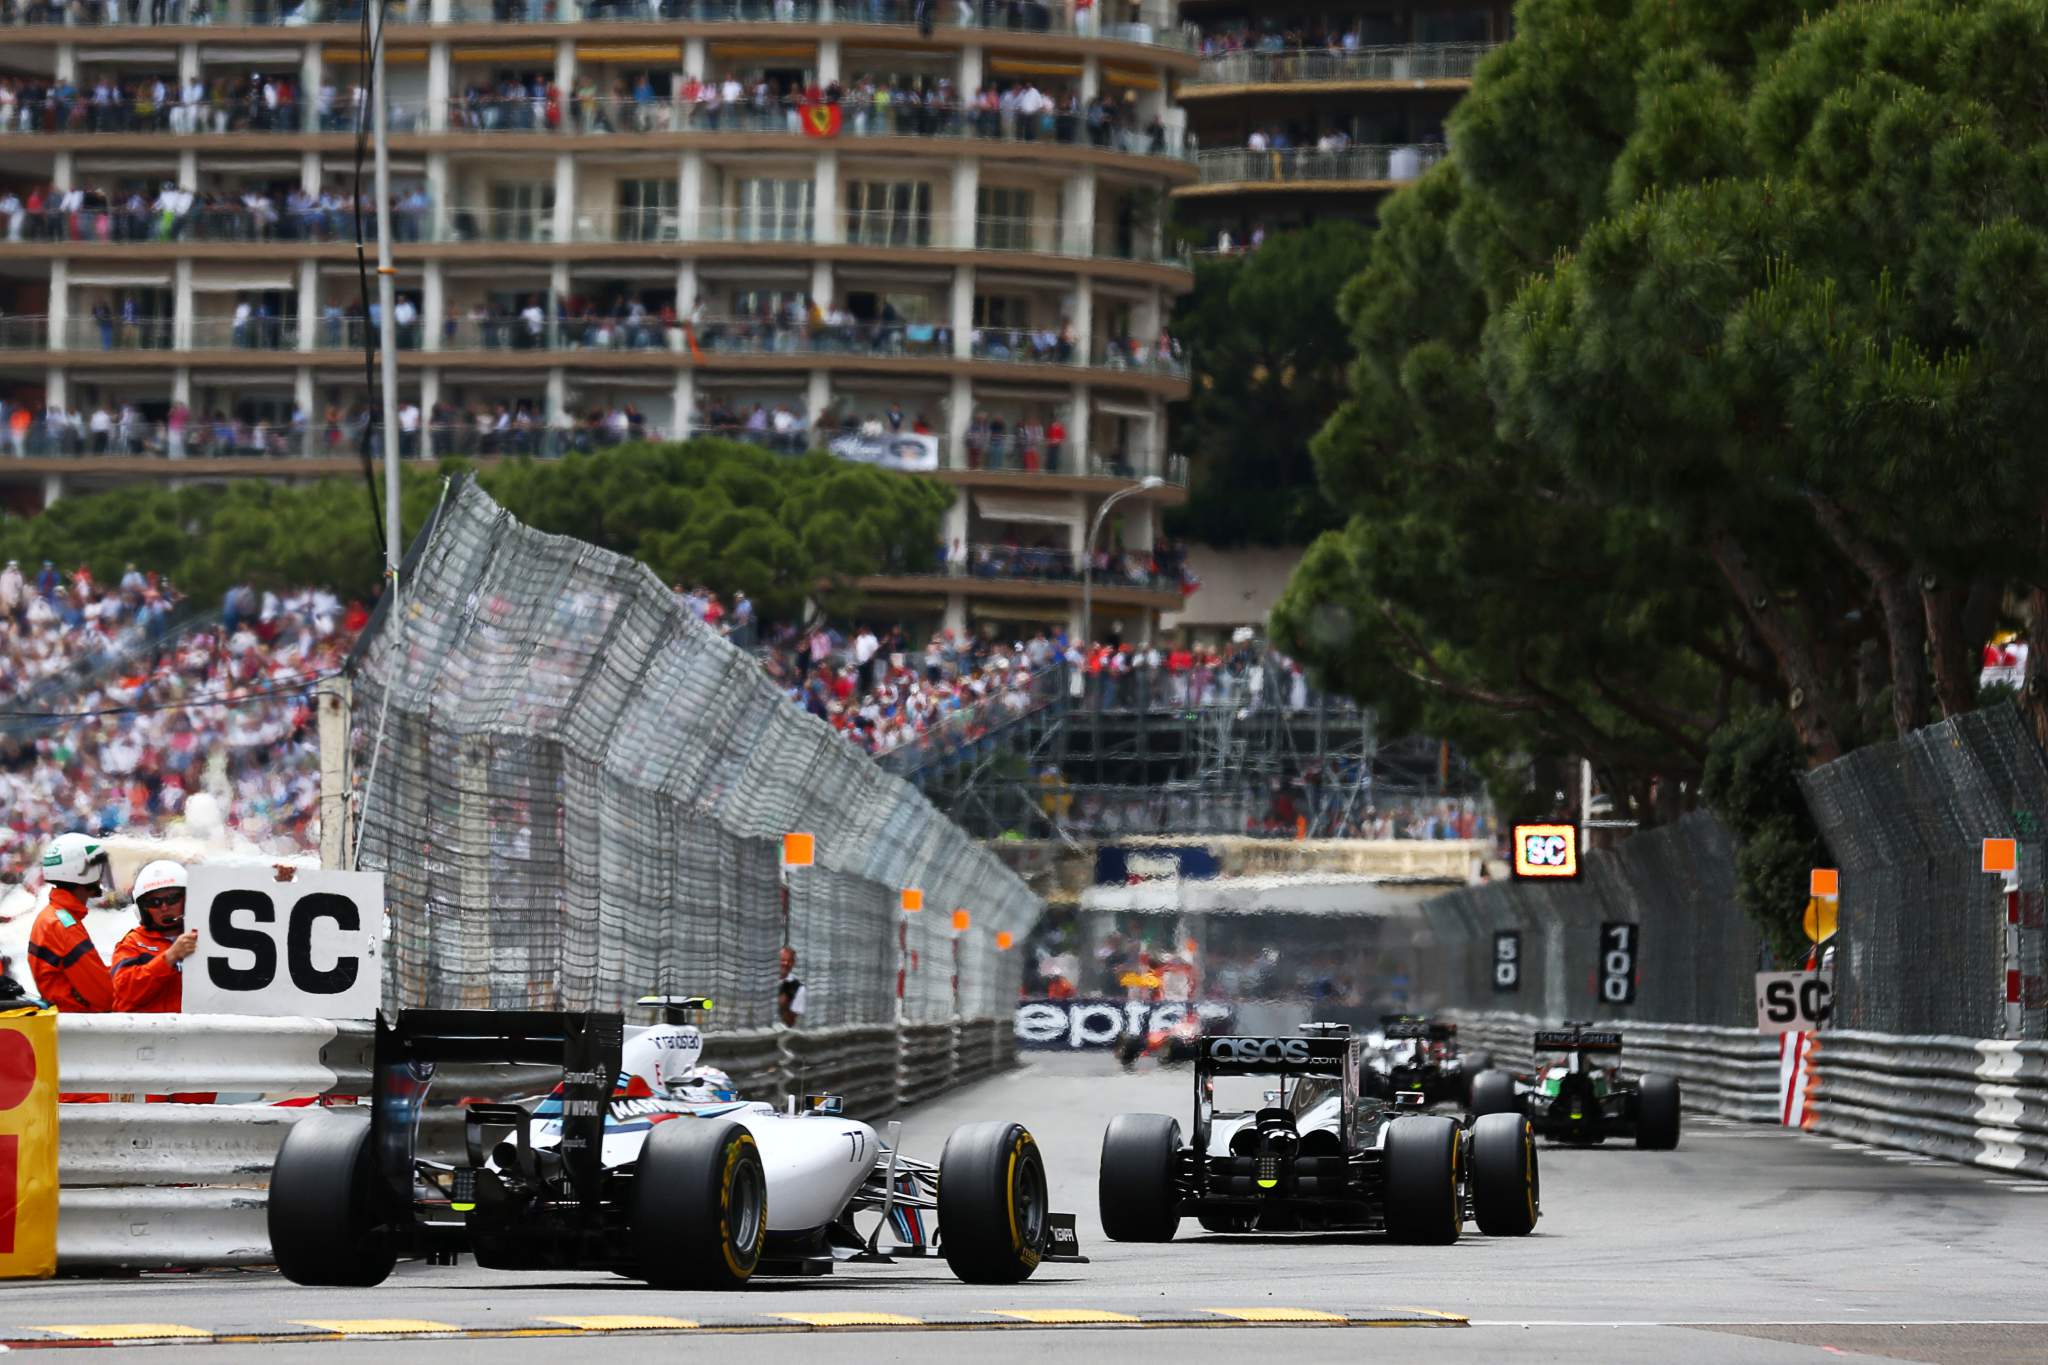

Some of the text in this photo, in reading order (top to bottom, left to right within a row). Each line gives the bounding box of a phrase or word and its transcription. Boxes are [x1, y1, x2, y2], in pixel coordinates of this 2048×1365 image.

[1526, 835, 1567, 866] SC
[207, 889, 361, 994] SC
[1496, 937, 1517, 986] 50
[1604, 925, 1630, 1001] 100
[1766, 980, 1832, 1023] SC
[842, 1130, 865, 1162] 77
